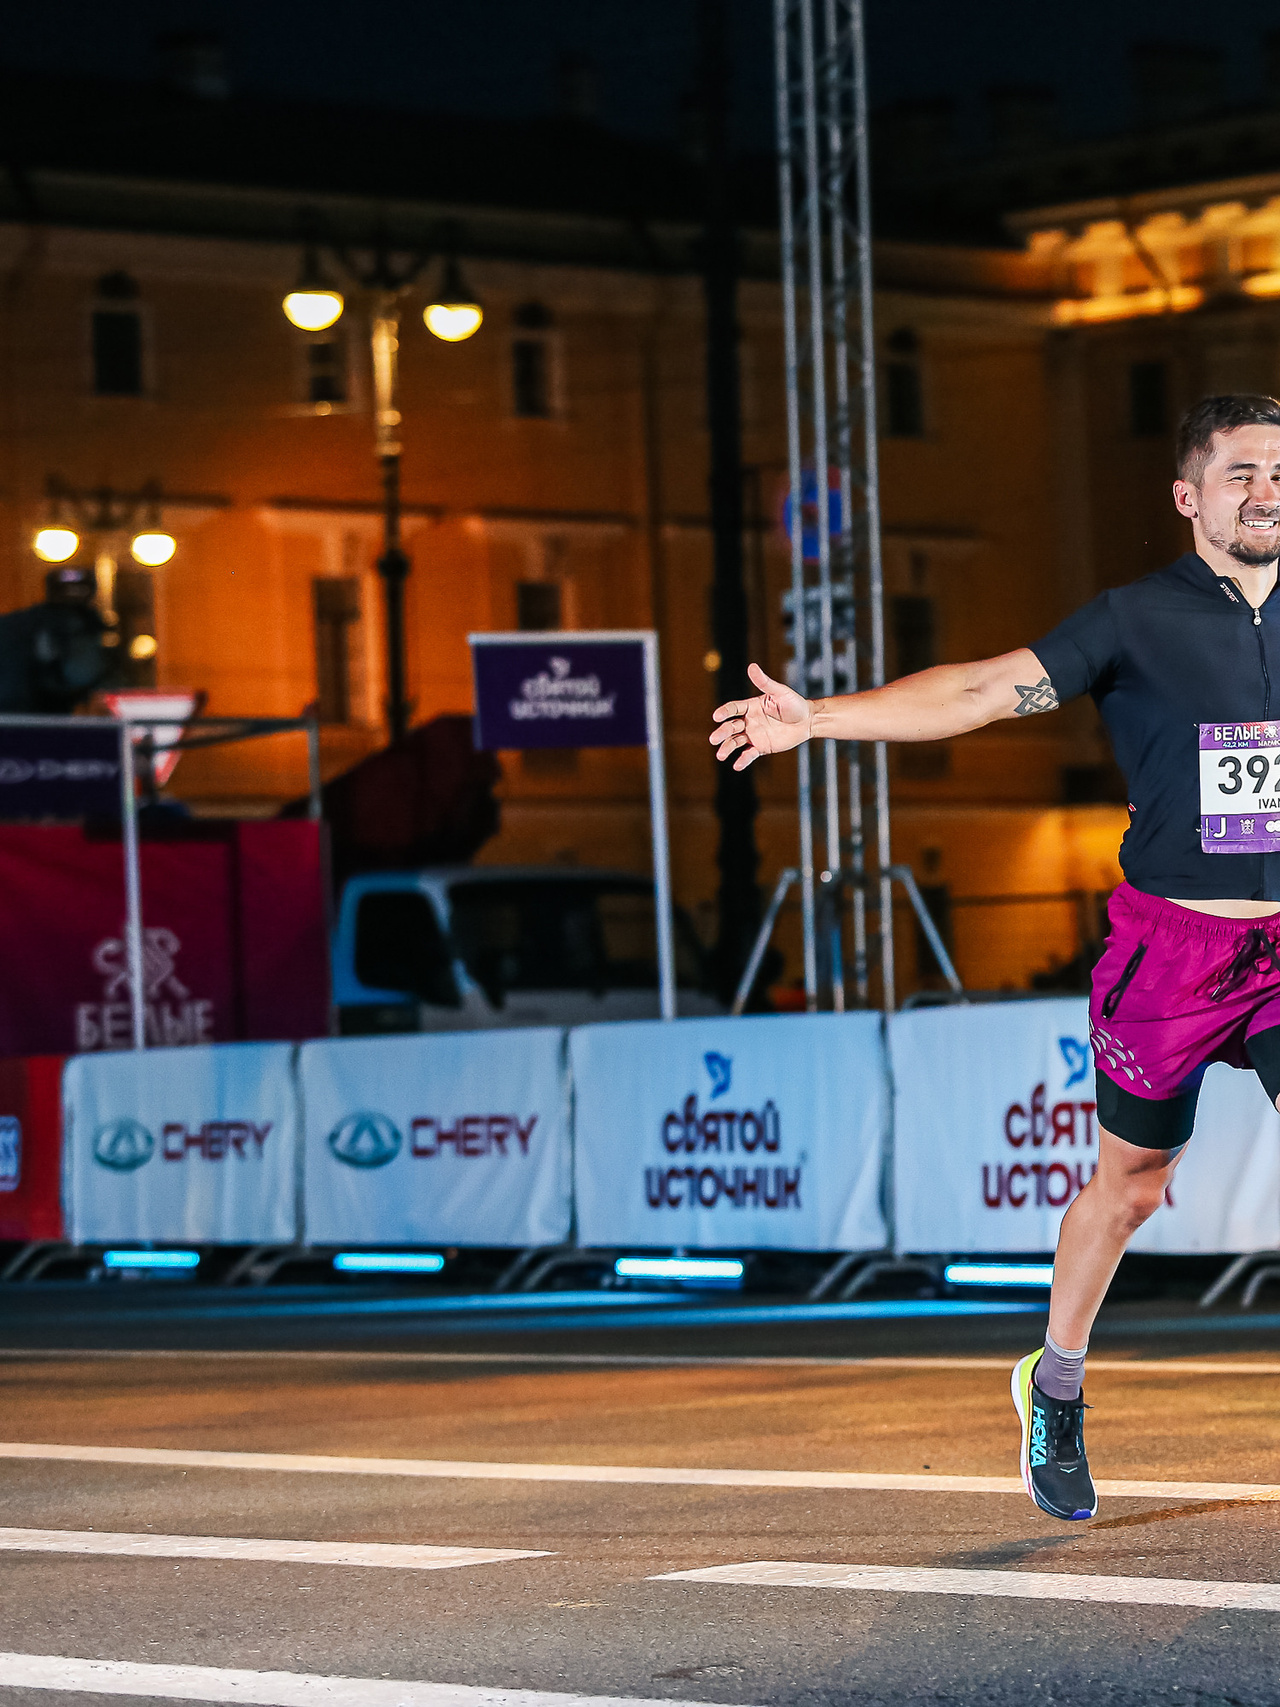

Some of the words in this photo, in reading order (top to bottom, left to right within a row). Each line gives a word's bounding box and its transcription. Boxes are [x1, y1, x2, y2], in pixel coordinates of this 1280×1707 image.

[1214, 725, 1261, 741] БЕЛЫЕ
[162, 1121, 273, 1161] CHERY
[411, 1113, 538, 1158] CHERY
[1030, 1405, 1047, 1468] HOKA
